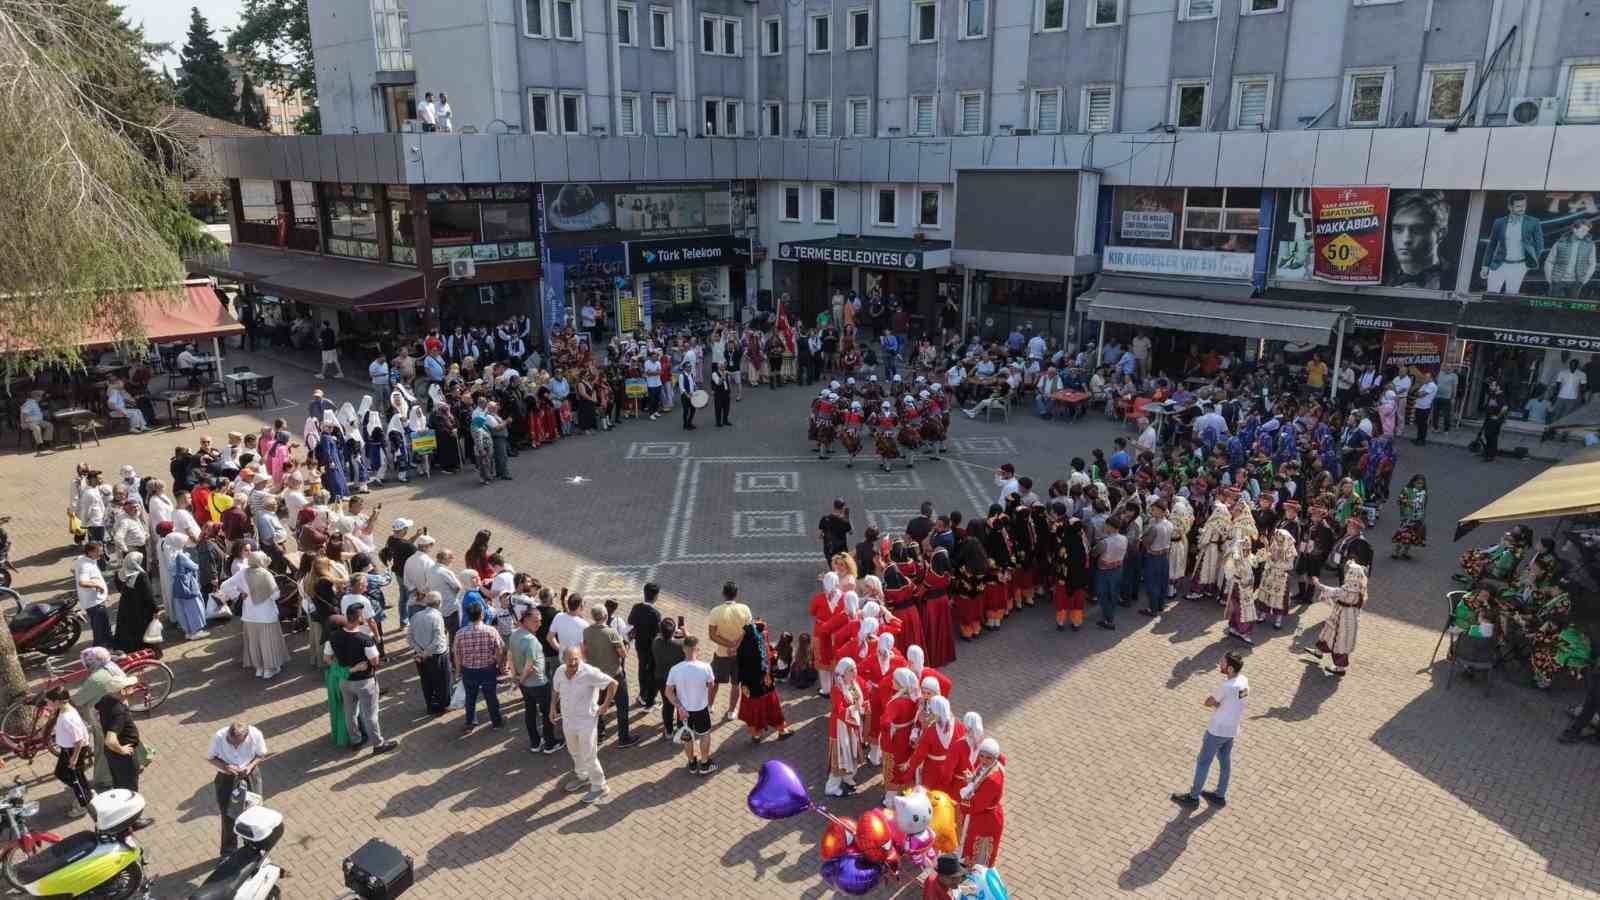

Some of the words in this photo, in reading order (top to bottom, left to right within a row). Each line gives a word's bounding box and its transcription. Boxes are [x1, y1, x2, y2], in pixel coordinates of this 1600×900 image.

[1316, 216, 1379, 234] AYAKKABIDA
[657, 249, 680, 262] Türk
[682, 246, 722, 261] Telekom
[793, 246, 832, 260] TERME
[1327, 244, 1350, 261] 50
[1493, 331, 1551, 345] YILMAZ
[1557, 338, 1600, 349] SPOR
